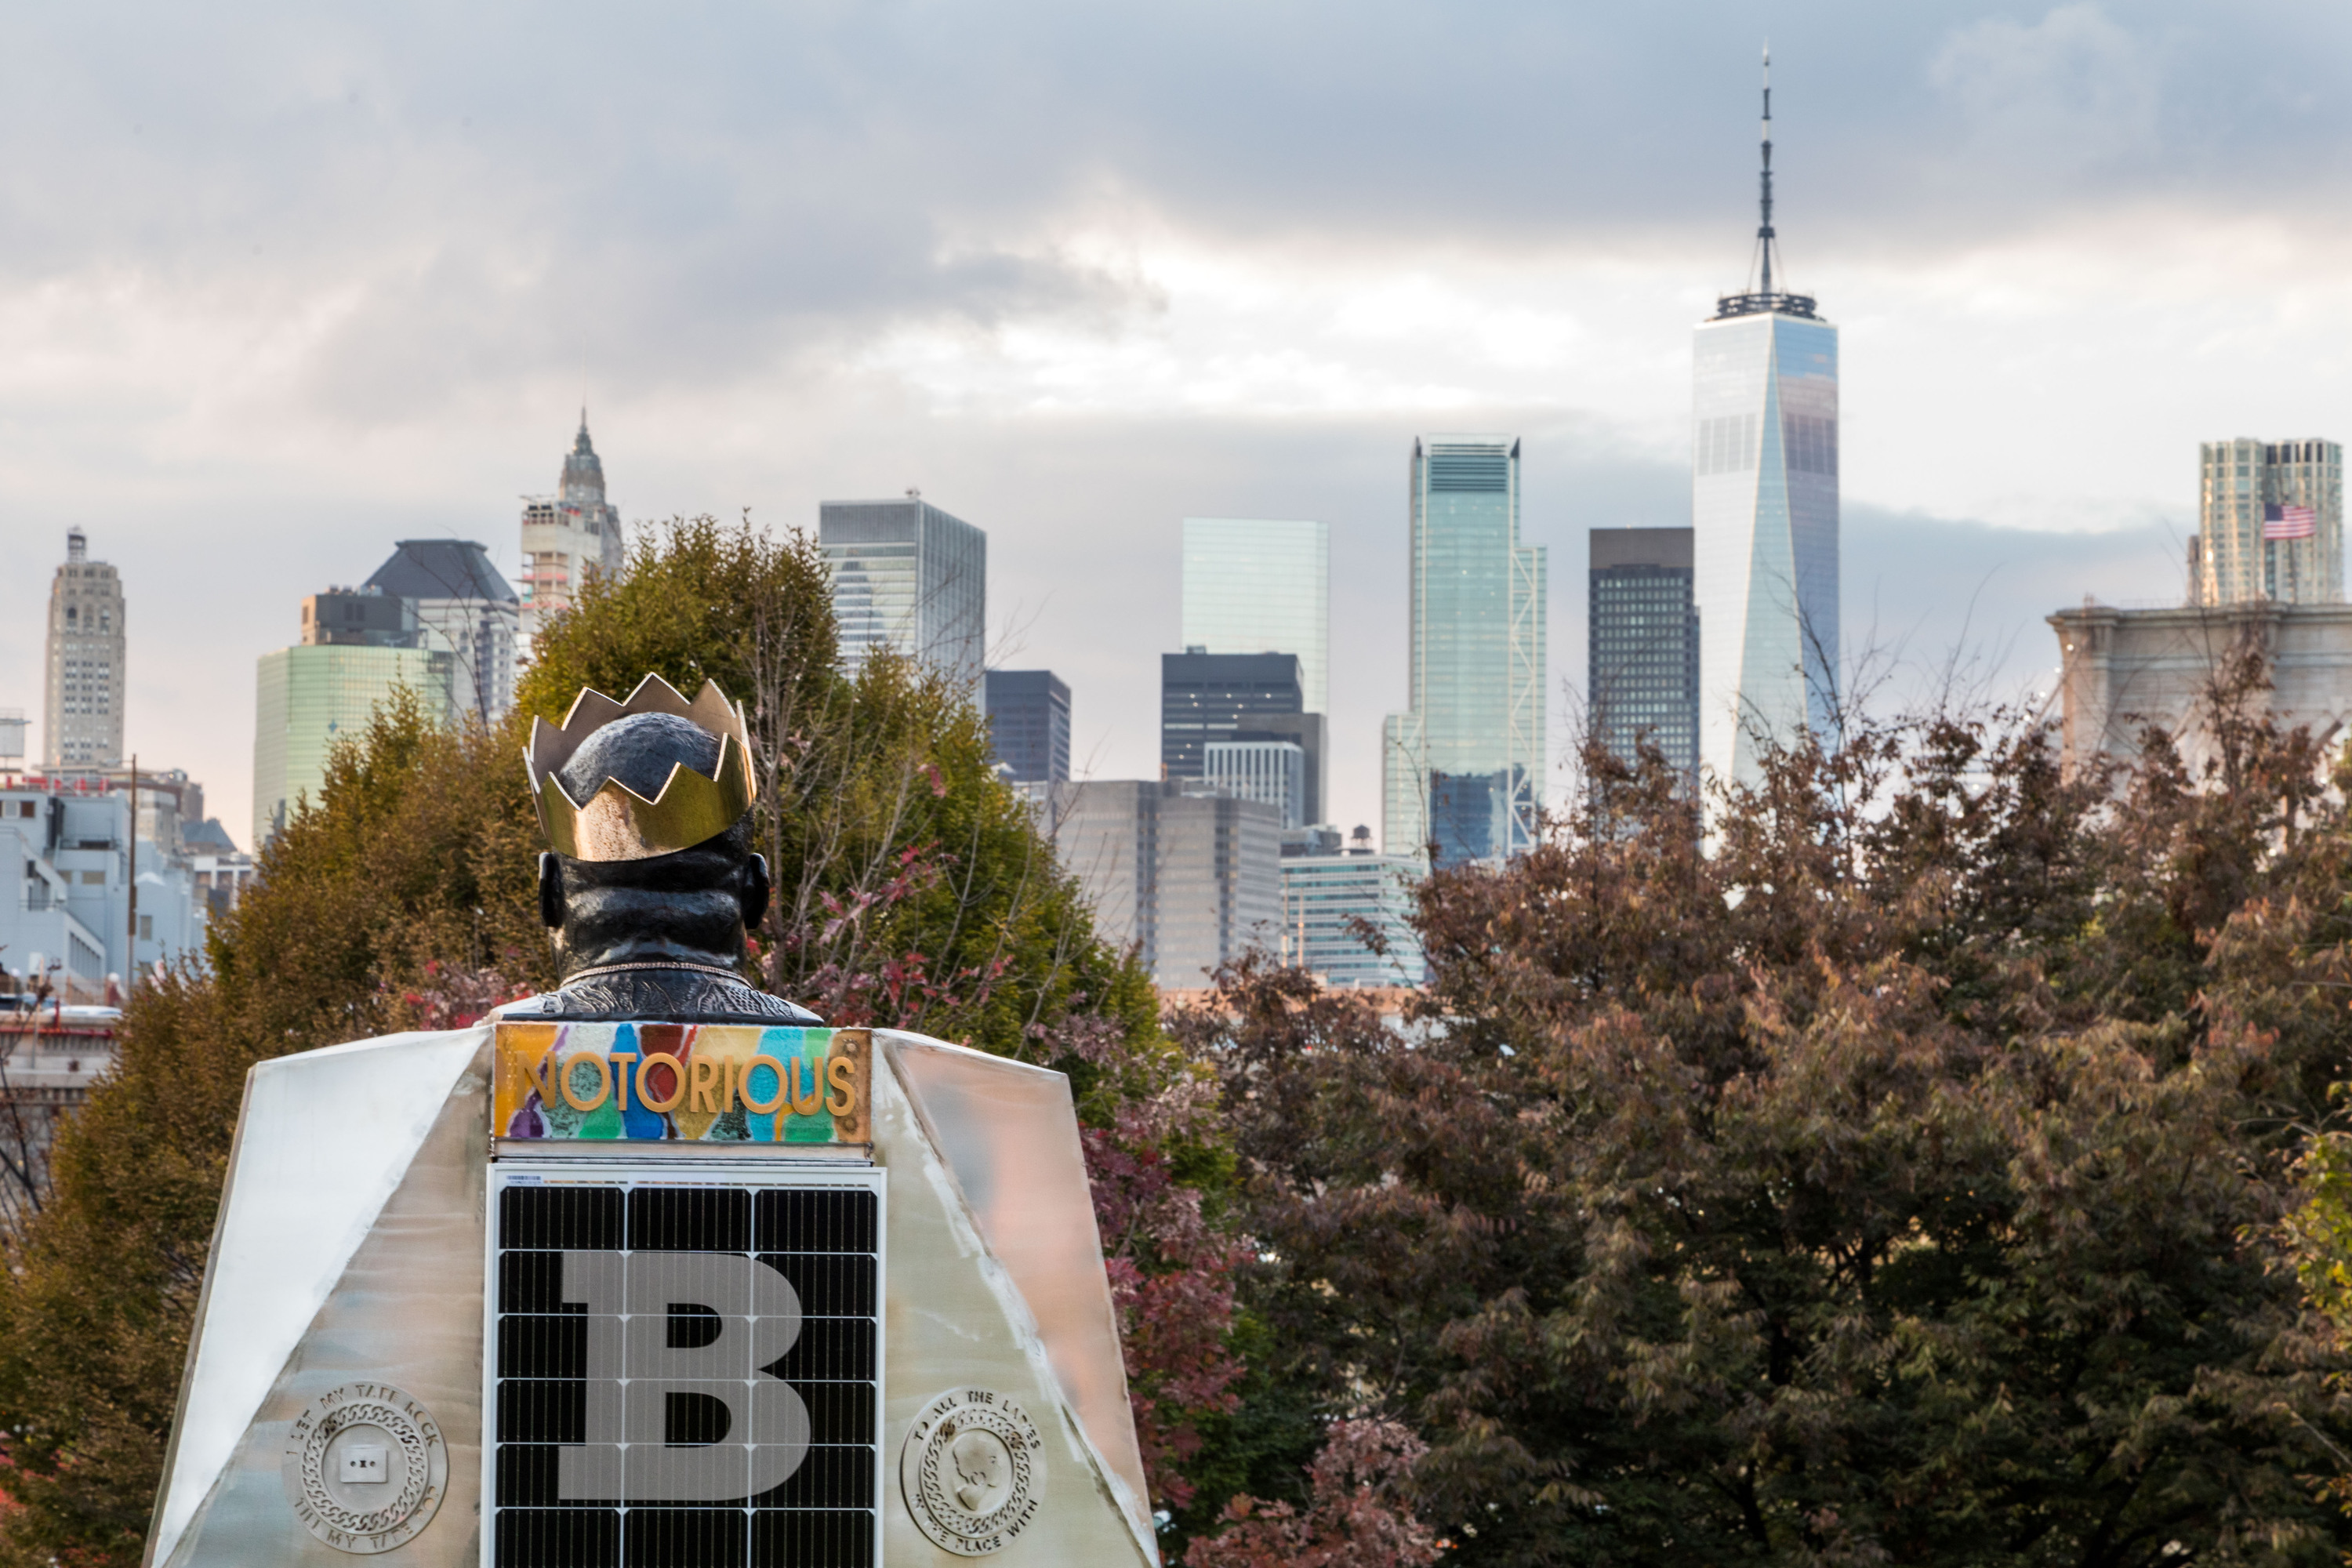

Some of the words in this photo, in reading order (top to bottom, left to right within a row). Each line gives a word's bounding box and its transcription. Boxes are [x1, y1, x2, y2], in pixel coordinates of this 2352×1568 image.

[515, 1051, 855, 1116] NOTORIOUS
[557, 1250, 811, 1501] B
[290, 1410, 314, 1443] LET
[320, 1388, 344, 1409] MY
[356, 1385, 400, 1403] TAPE
[405, 1401, 440, 1448] ROCK
[913, 1421, 930, 1441] TO
[934, 1397, 957, 1419] ALL
[967, 1391, 993, 1404] THE
[327, 1530, 356, 1548] MY
[955, 1536, 1002, 1552] PLACE
[1007, 1499, 1038, 1537] WITH
